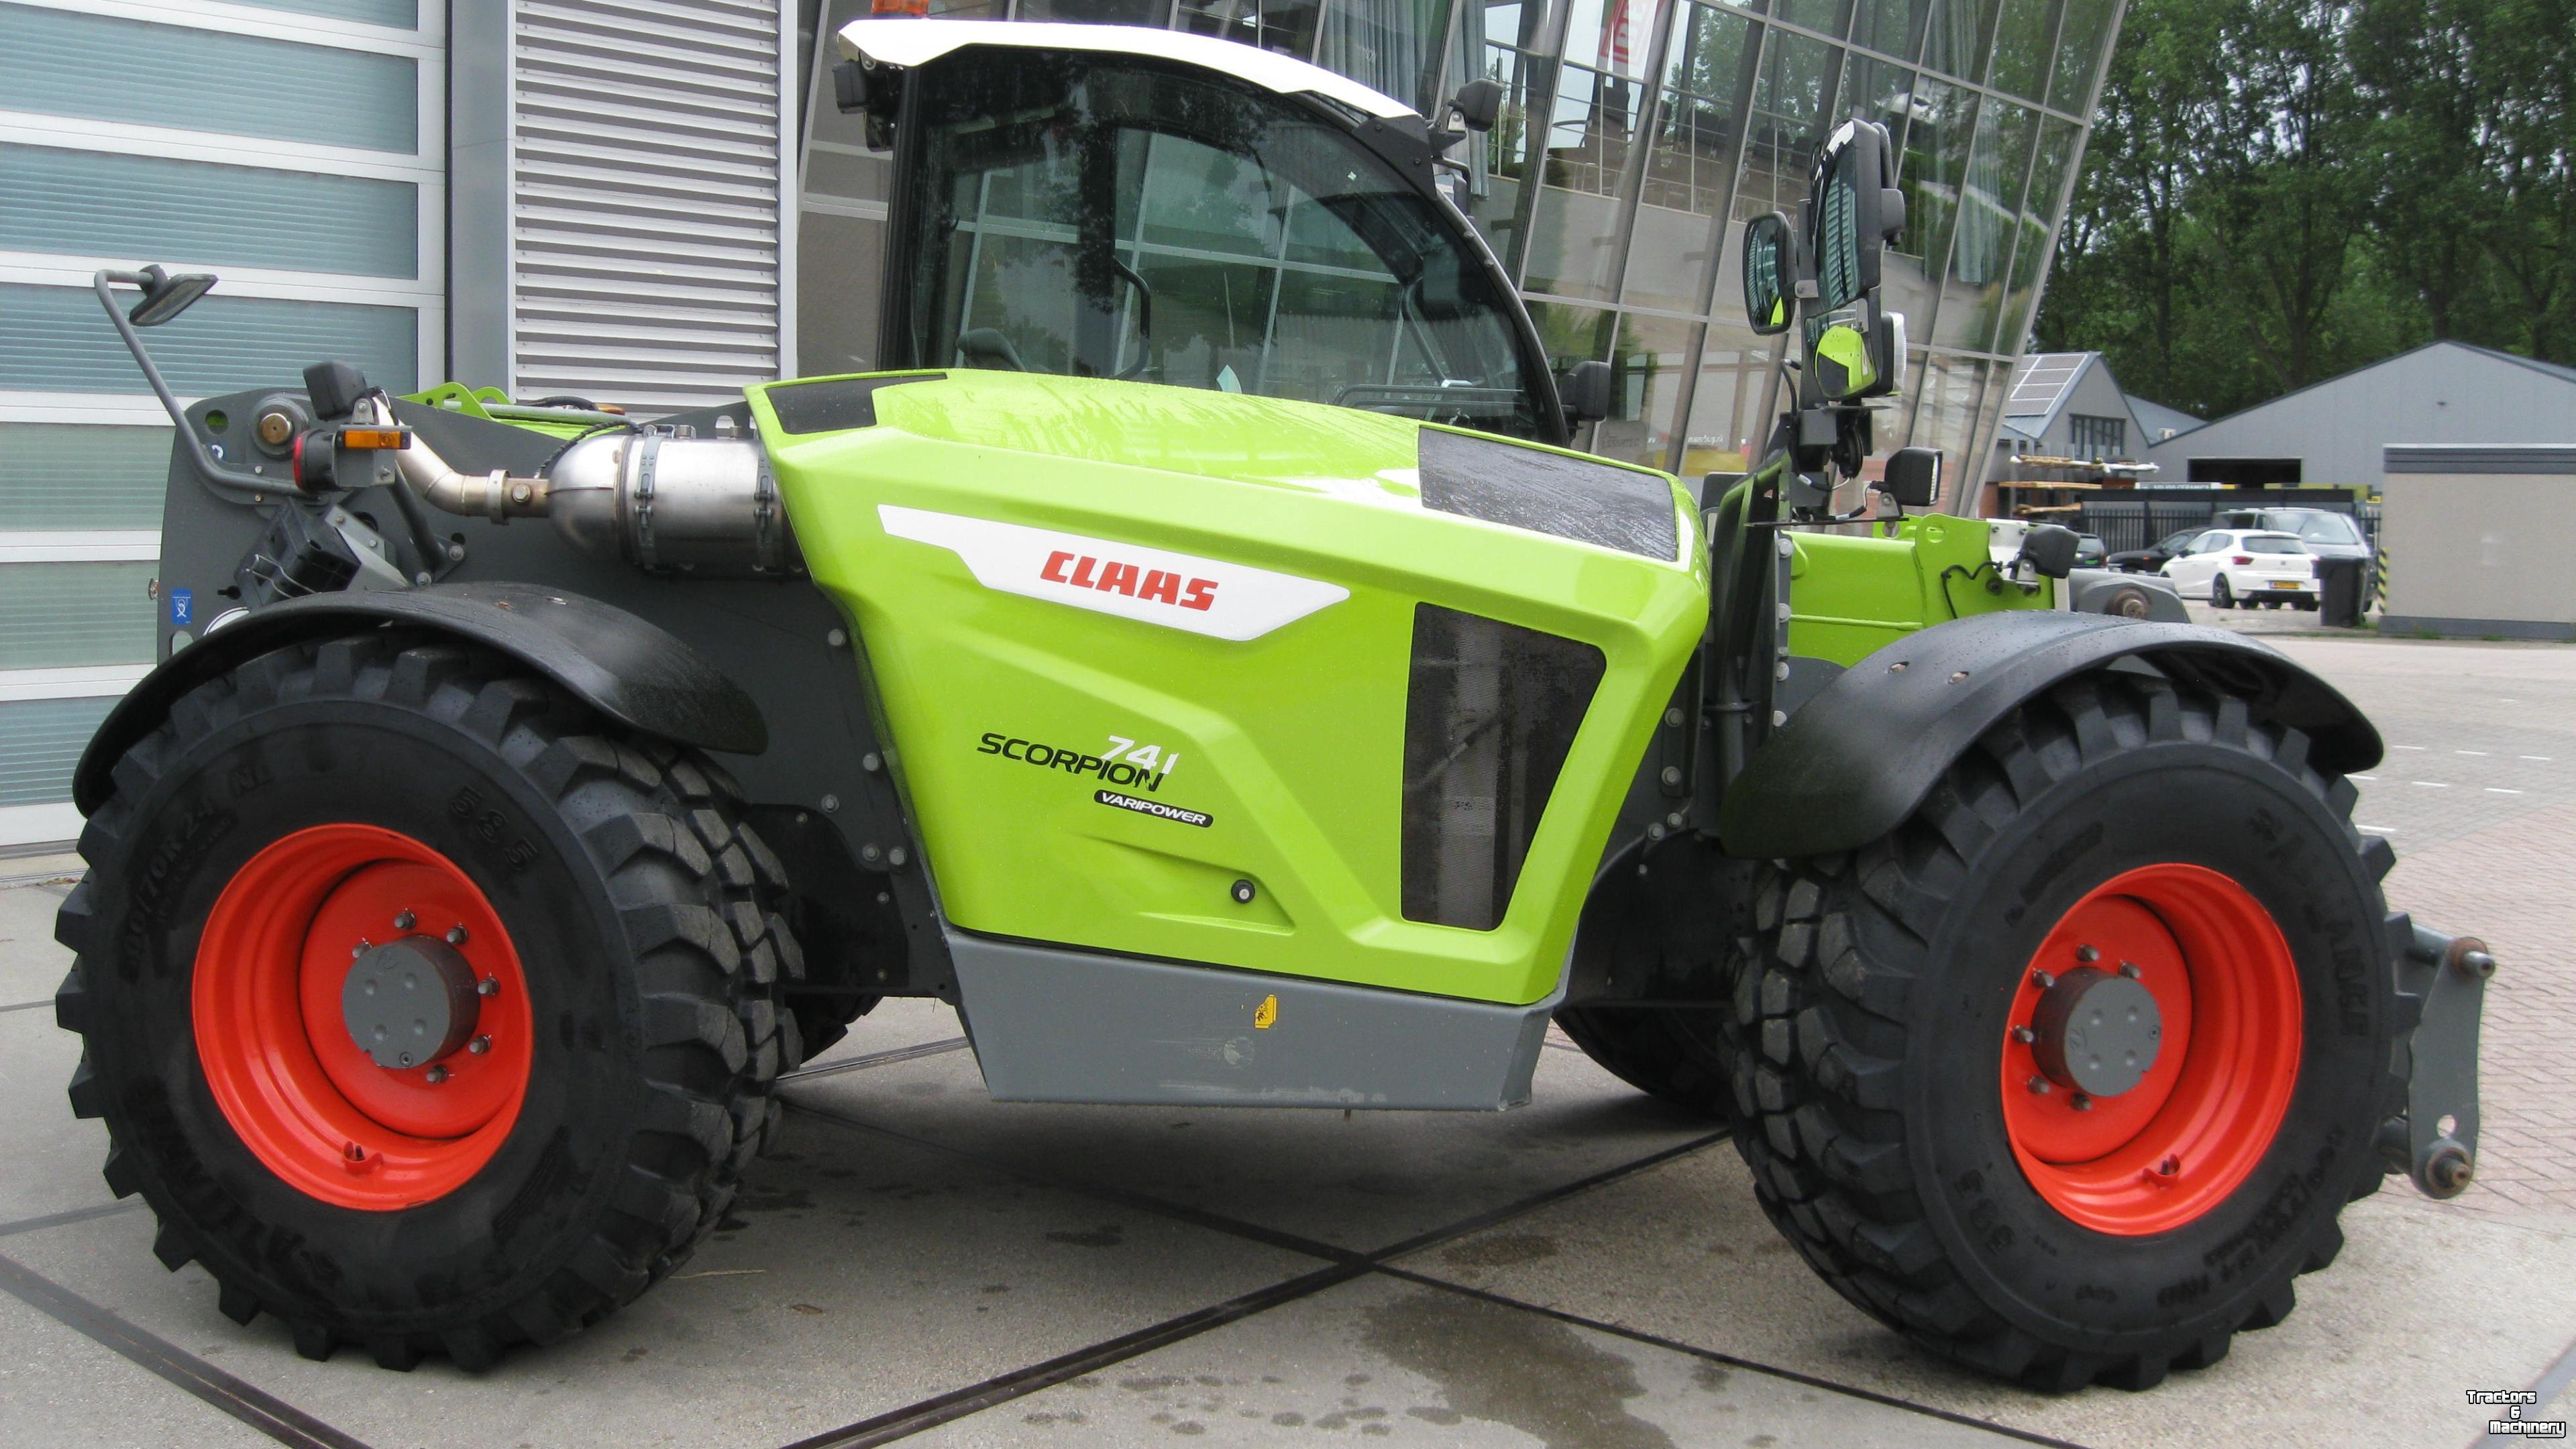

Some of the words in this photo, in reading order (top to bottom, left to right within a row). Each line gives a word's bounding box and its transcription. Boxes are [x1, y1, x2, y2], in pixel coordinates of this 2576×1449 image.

[1040, 550, 1219, 611] CLAAS
[977, 733, 1165, 792] SCORPION
[1100, 735, 1179, 775] 741
[450, 784, 539, 871] 585
[1101, 792, 1207, 825] VARIPOWER
